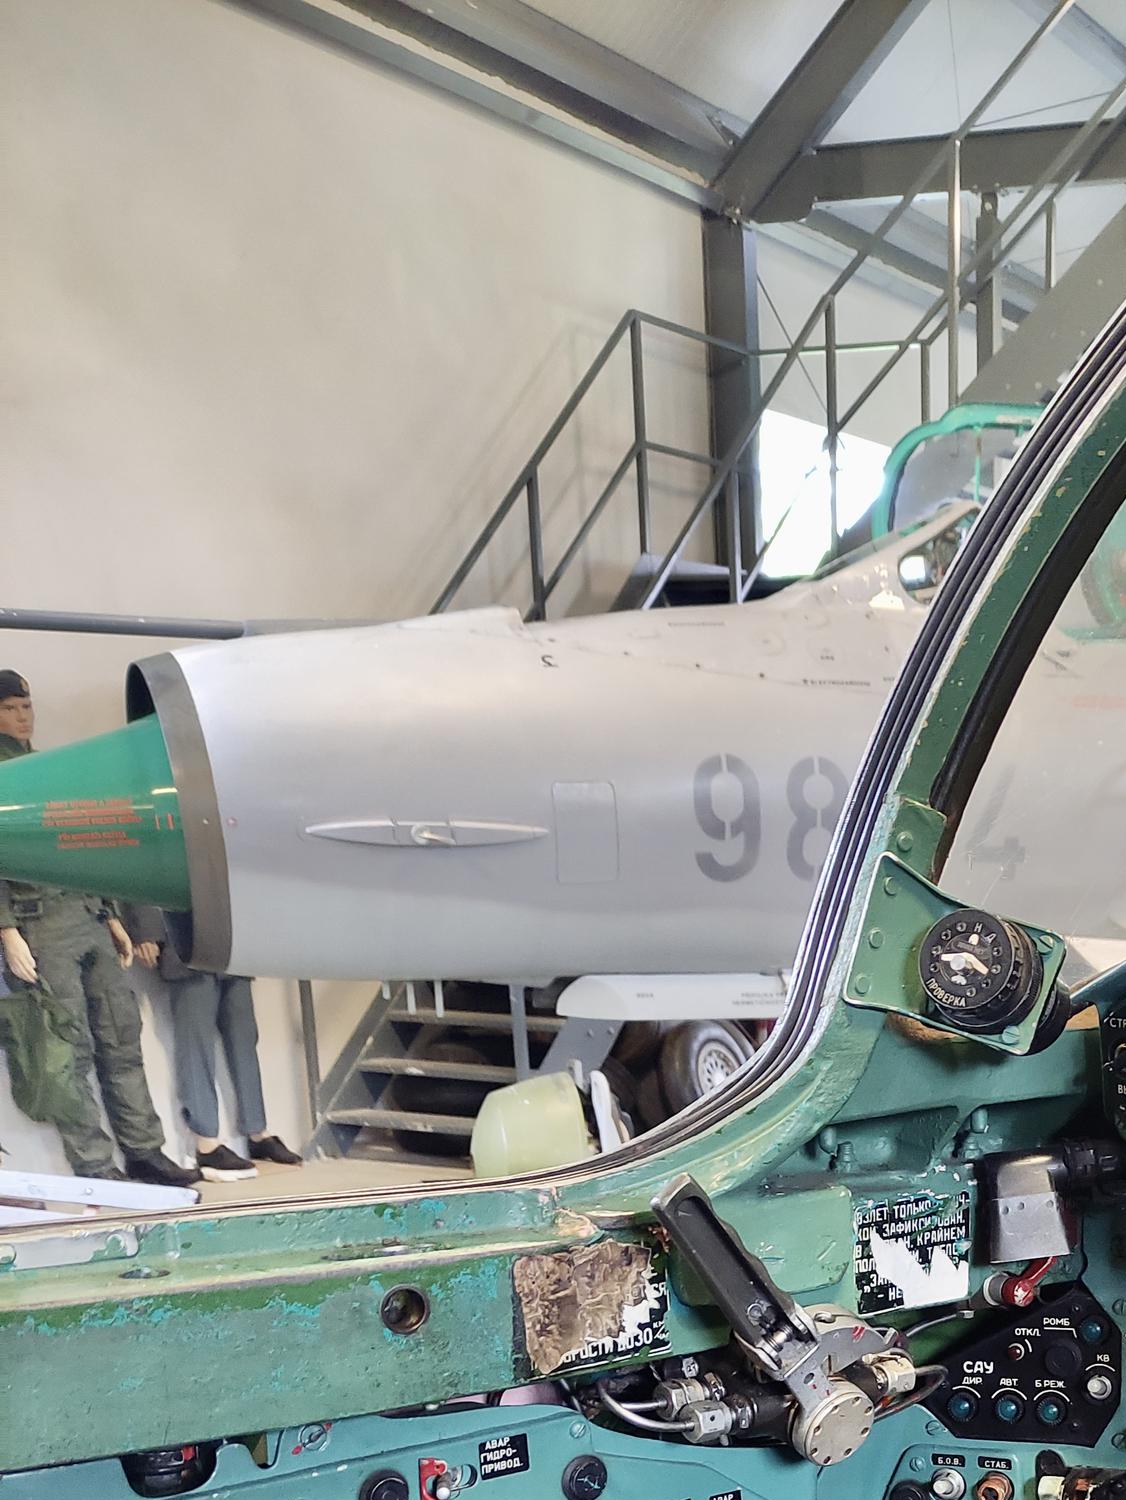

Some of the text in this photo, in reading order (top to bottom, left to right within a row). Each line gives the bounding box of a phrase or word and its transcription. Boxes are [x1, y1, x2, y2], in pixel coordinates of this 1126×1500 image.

[926, 978, 966, 1008] ПРОВЕРКА
[1043, 1318, 1070, 1326] РОМБ
[964, 1361, 994, 1374] САУ
[480, 1448, 517, 1463] ГИДРО-
[481, 1459, 524, 1475] ПРИВОД.
